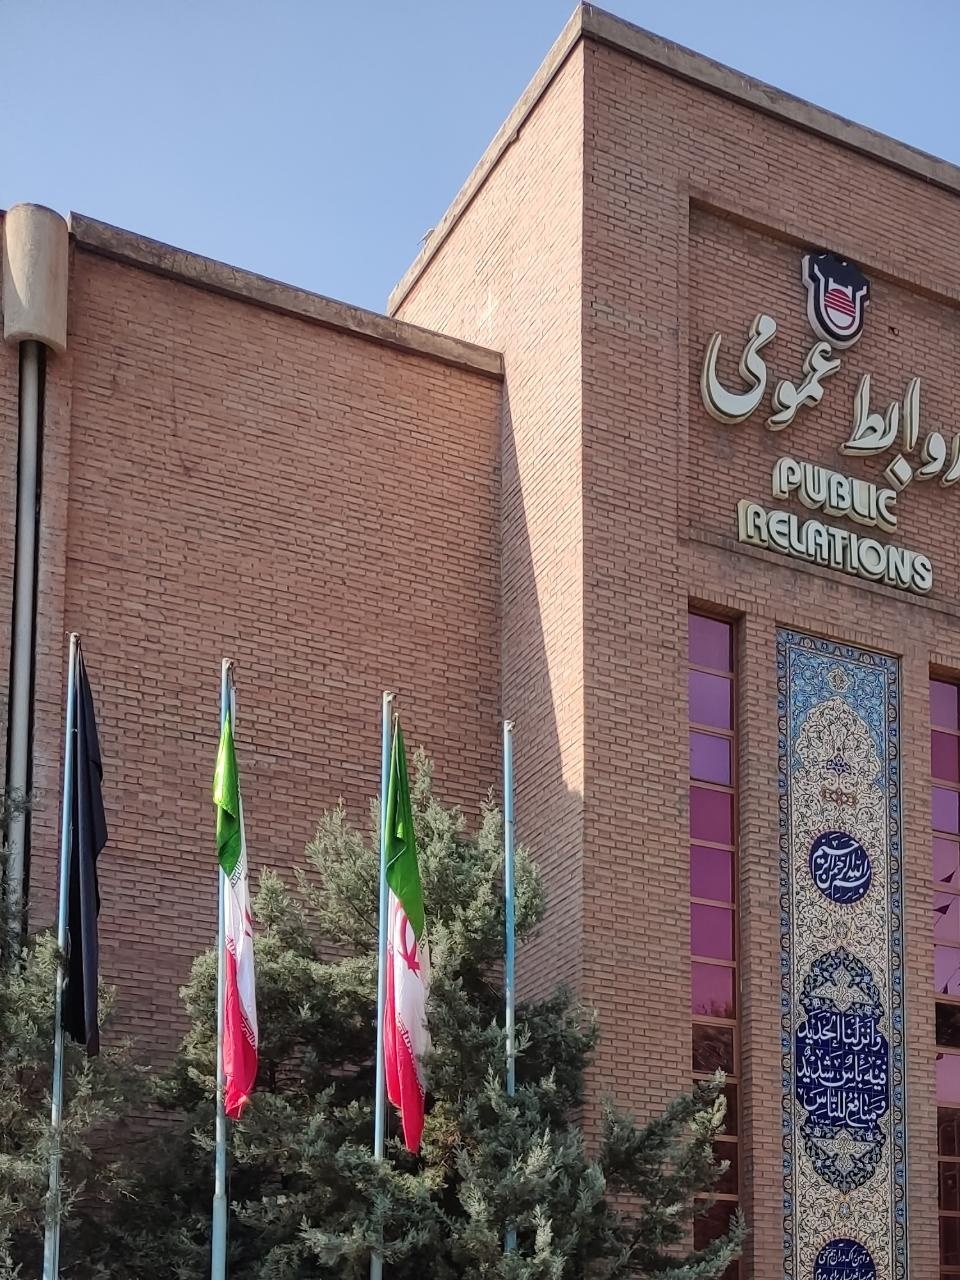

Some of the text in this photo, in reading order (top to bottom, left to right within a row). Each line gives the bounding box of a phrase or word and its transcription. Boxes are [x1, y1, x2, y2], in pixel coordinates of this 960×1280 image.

[701, 313, 841, 432] عمومی
[772, 456, 898, 533] PUBLIC
[737, 499, 933, 594] RELATIONS
